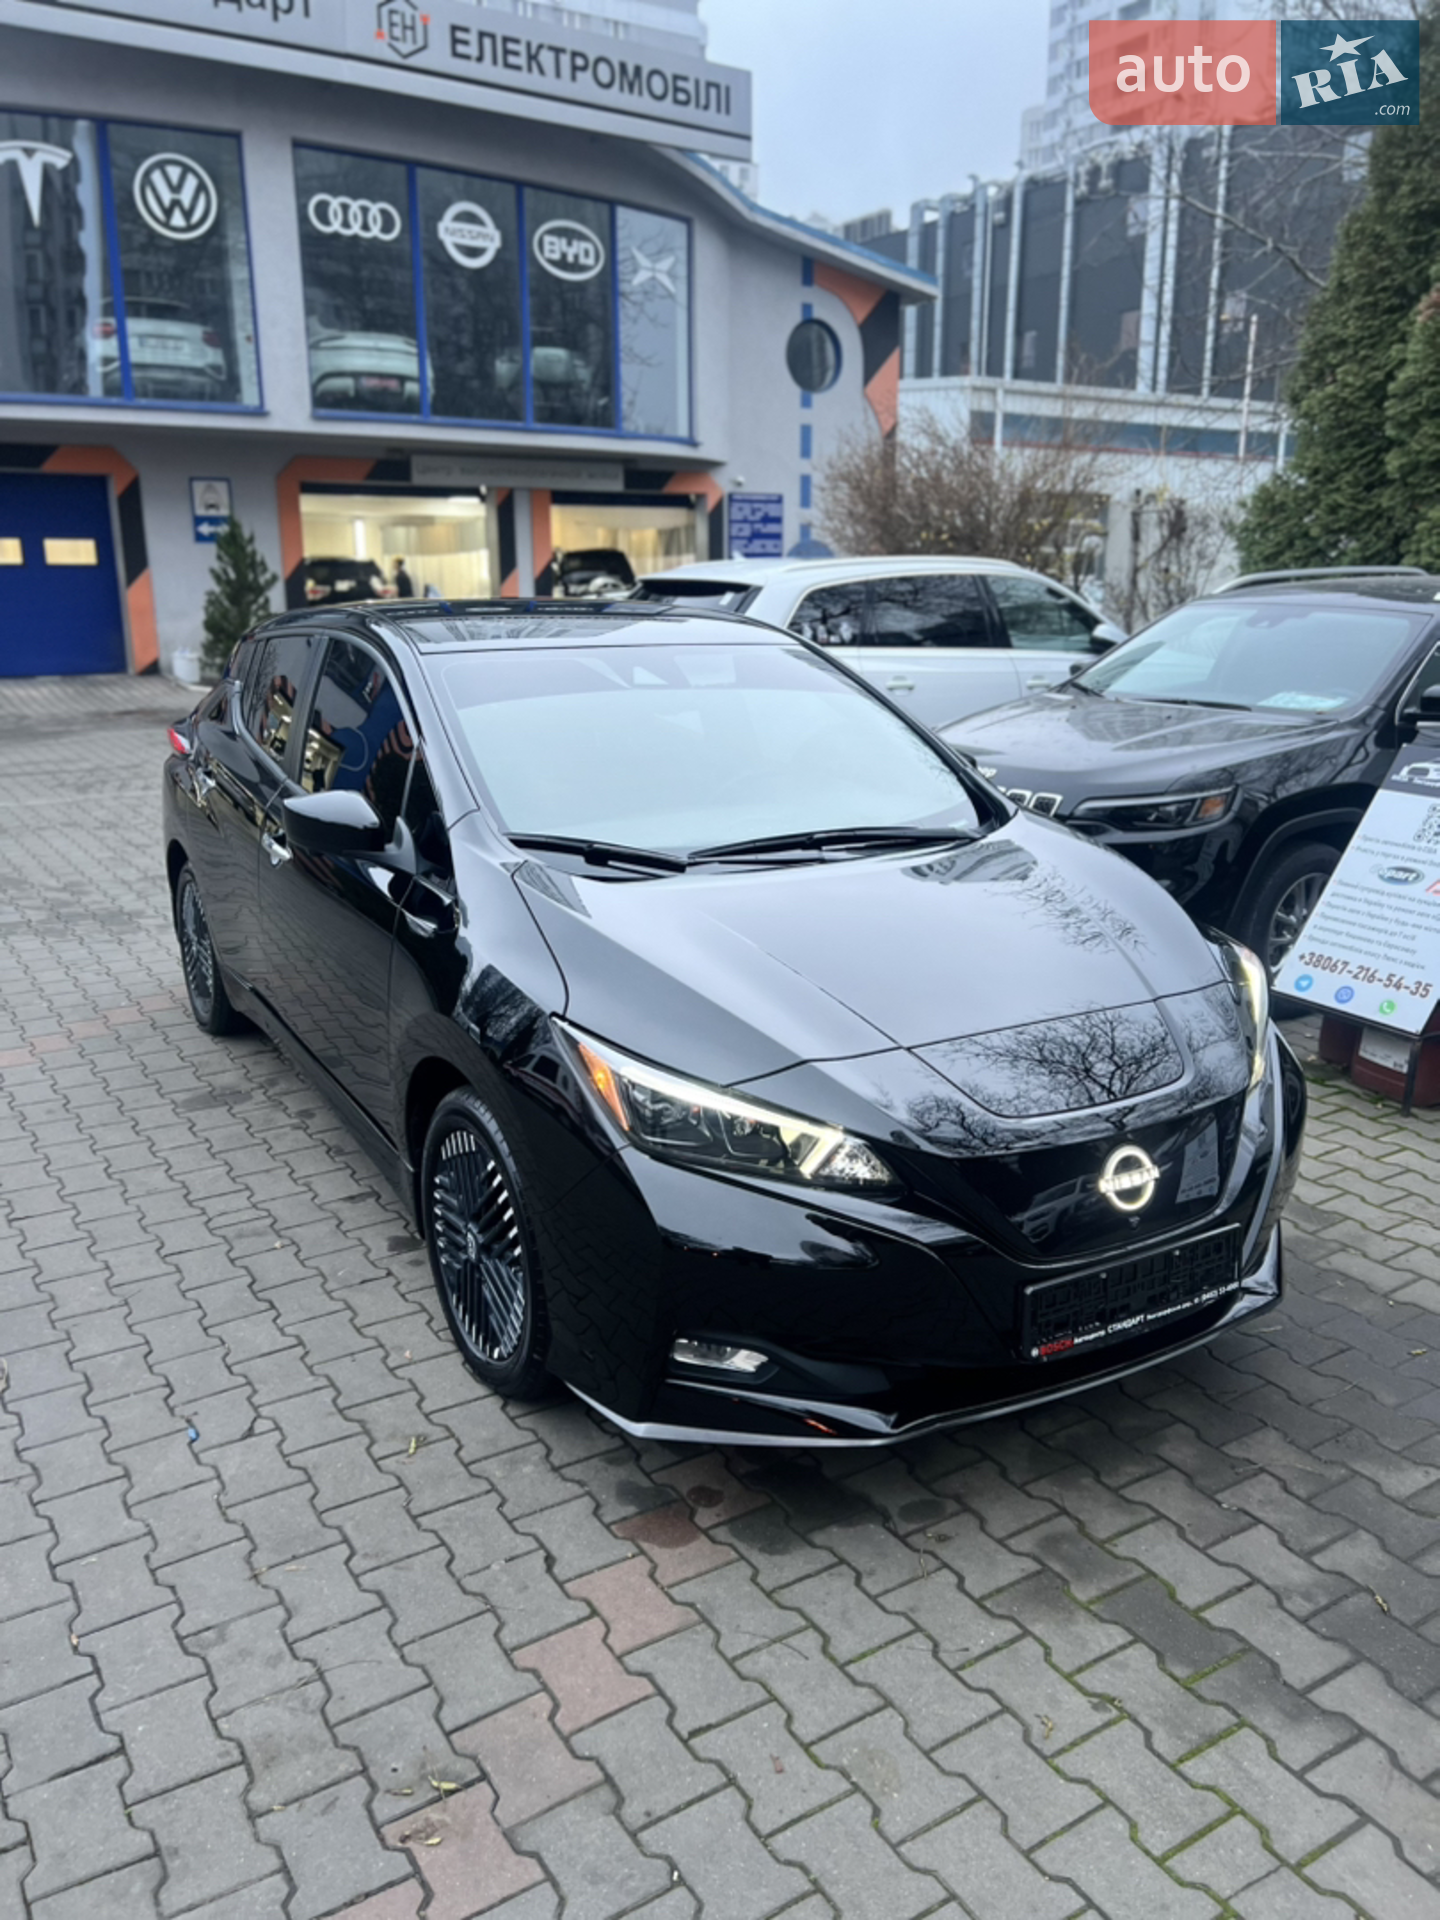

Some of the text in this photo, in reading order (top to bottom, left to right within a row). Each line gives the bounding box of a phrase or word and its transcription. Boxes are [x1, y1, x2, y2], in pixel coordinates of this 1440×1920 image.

[449, 23, 731, 116] ЕЛЕКТРОМОБІЛІ
[443, 224, 496, 244] NISSAN
[542, 234, 596, 267] BYD
[1298, 951, 1433, 998] +38067-216-54-35
[1098, 1166, 1160, 1194] NISSAN
